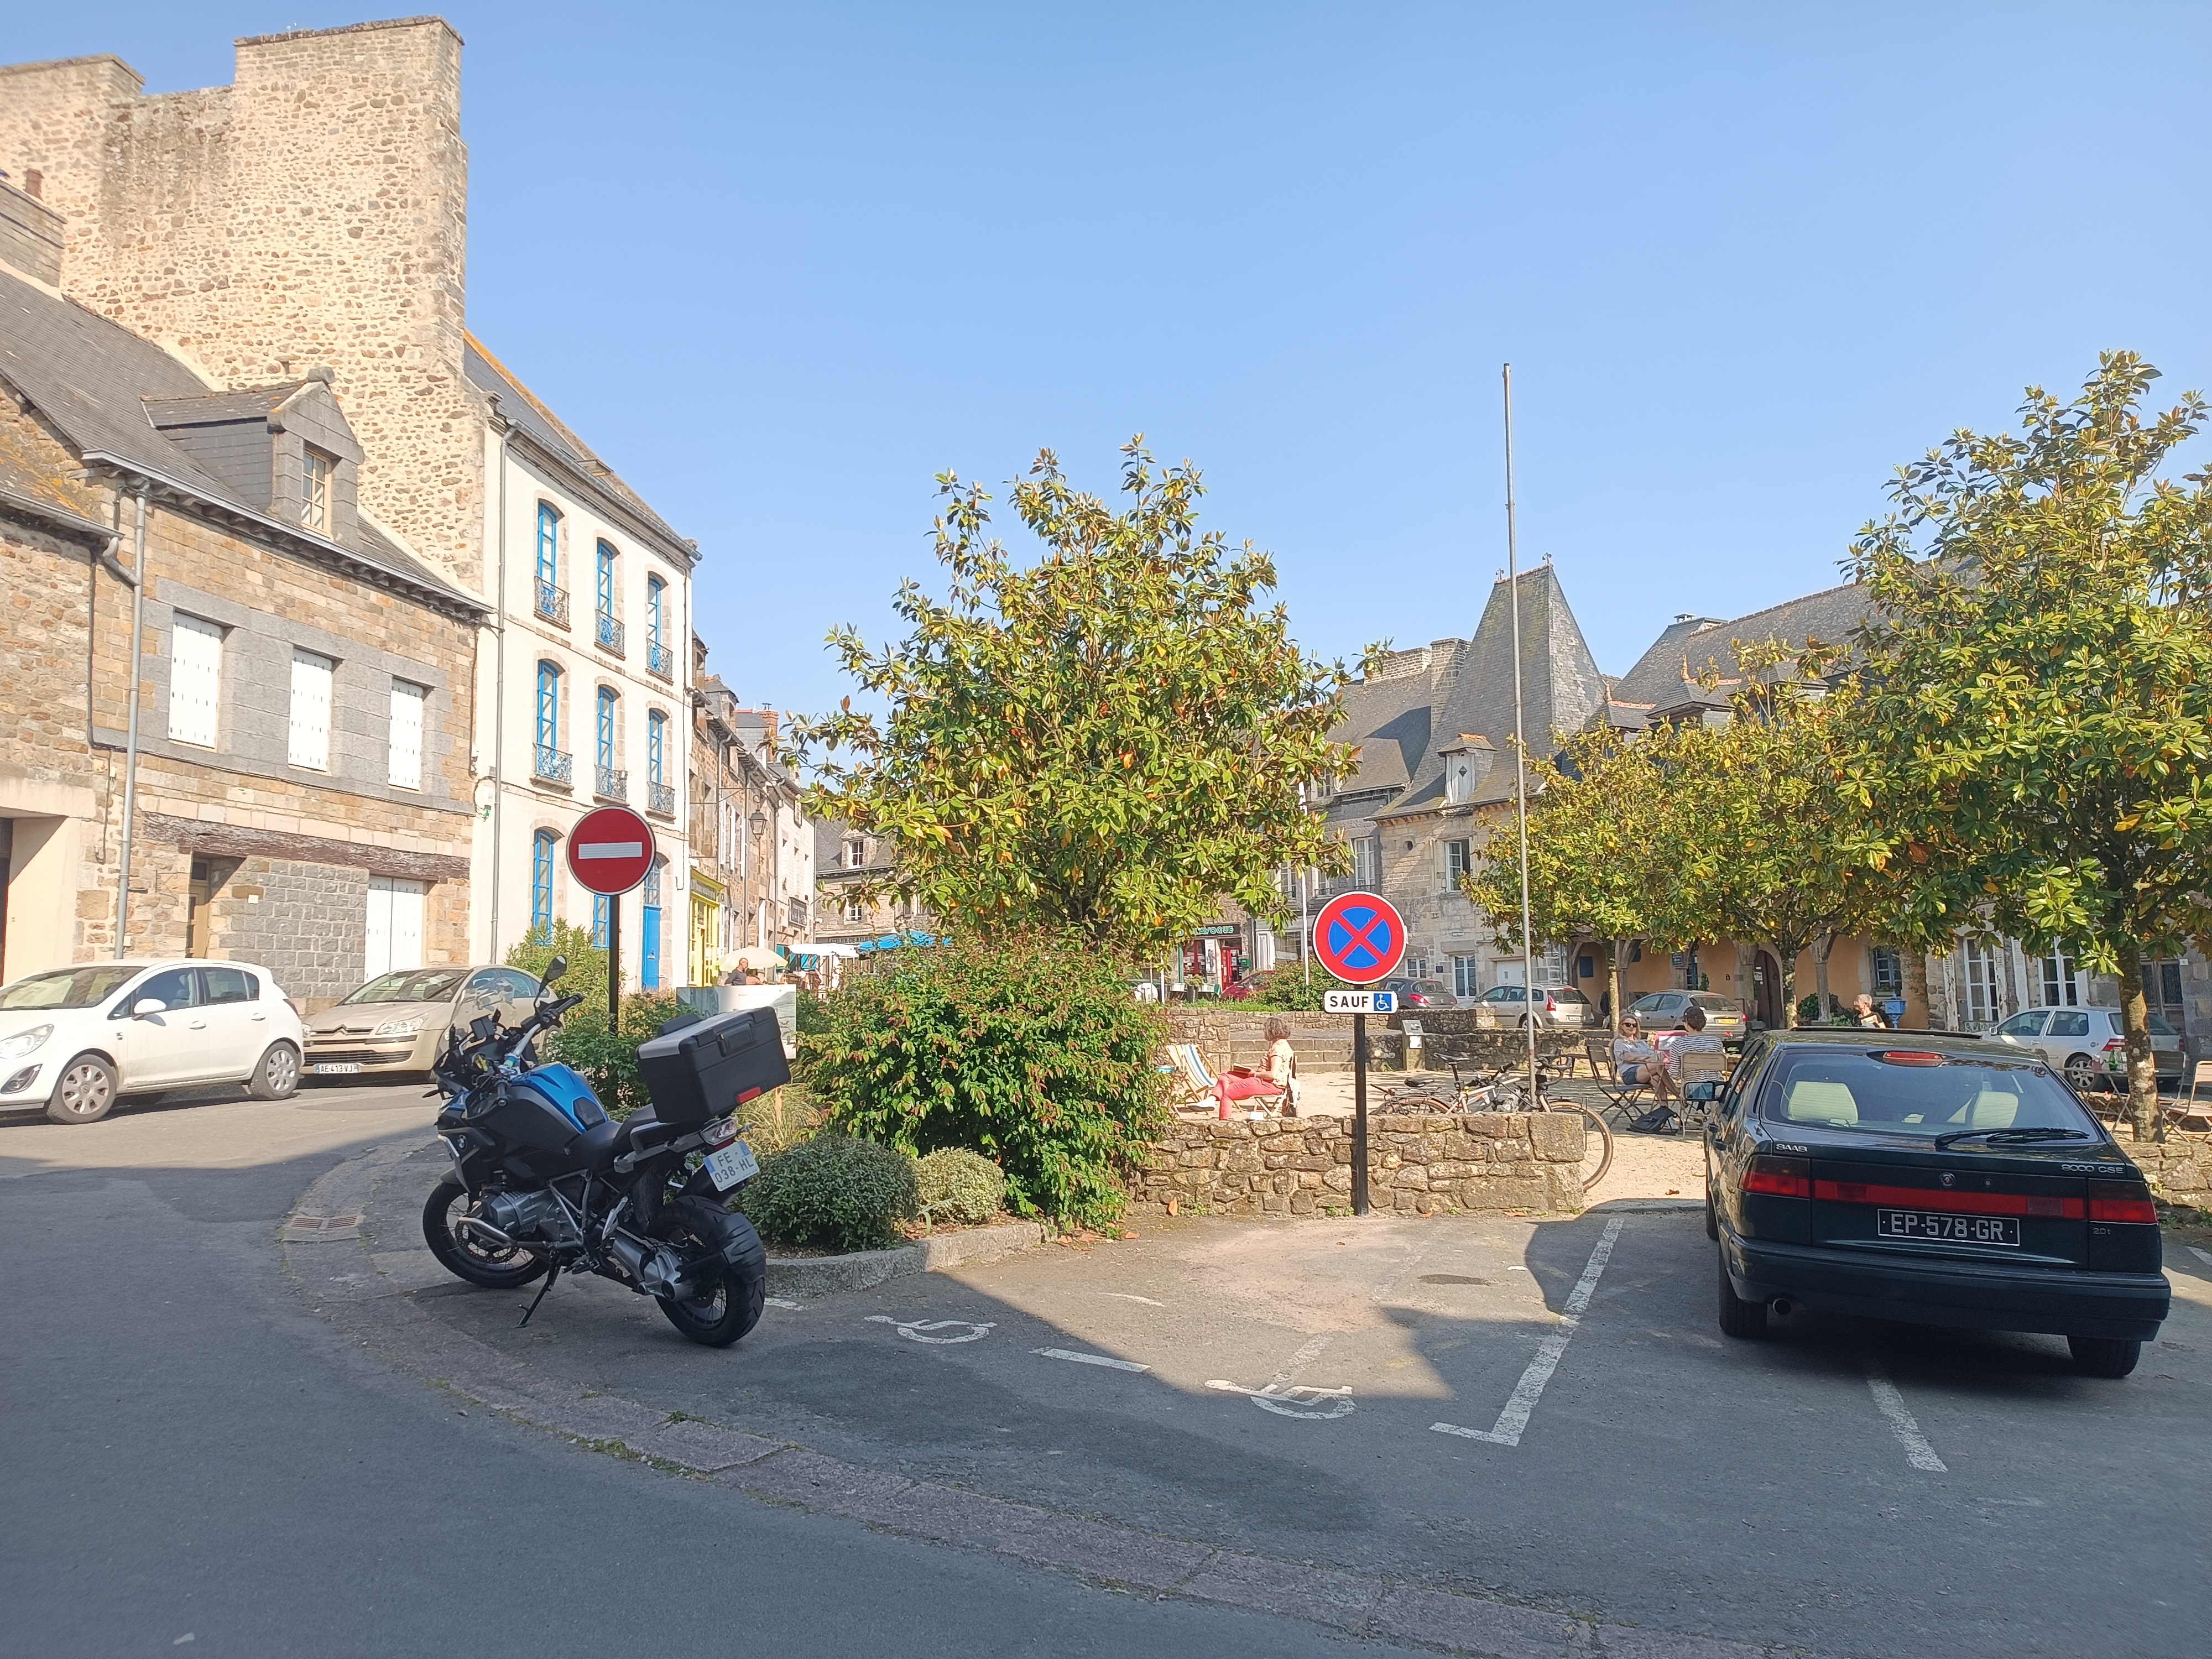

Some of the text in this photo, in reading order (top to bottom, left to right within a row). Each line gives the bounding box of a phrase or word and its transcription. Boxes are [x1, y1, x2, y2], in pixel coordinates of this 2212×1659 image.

[1330, 996, 1369, 1008] SAUF
[1776, 1144, 1808, 1152] SAAB
[714, 1157, 754, 1183] 038-HL
[2061, 1164, 2095, 1172] 9000
[1891, 1213, 2004, 1240] EP-578-GR
